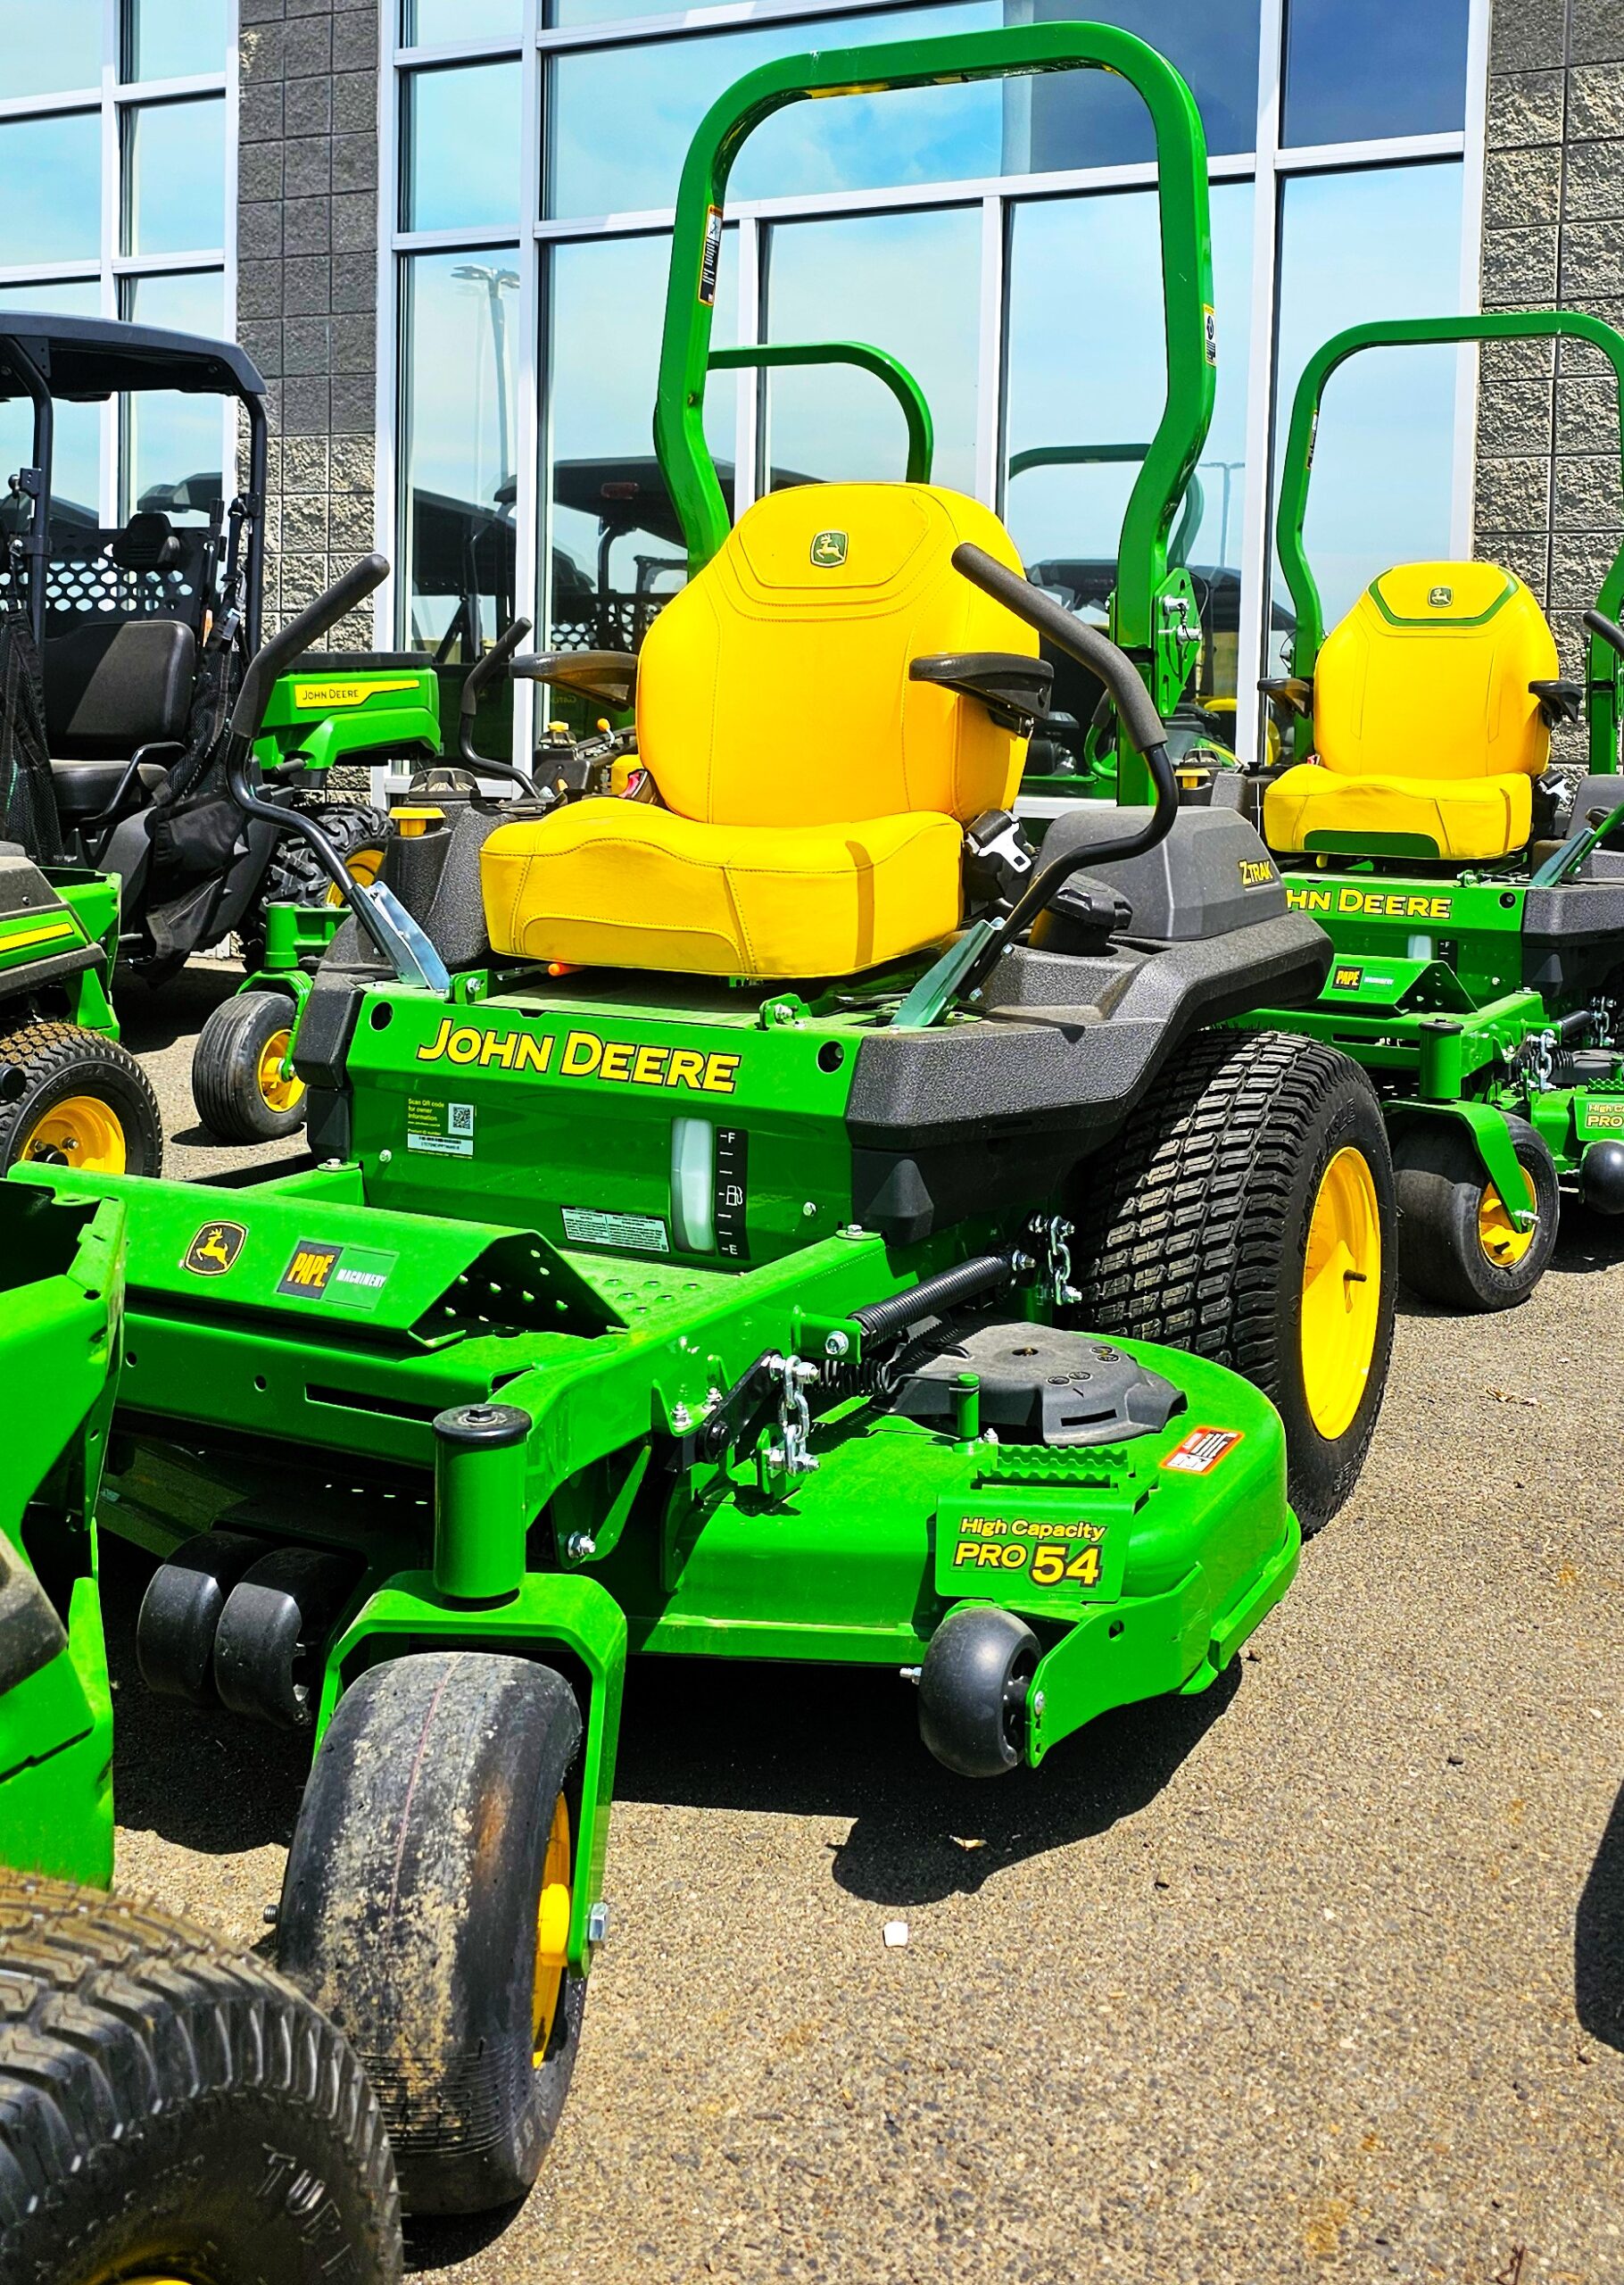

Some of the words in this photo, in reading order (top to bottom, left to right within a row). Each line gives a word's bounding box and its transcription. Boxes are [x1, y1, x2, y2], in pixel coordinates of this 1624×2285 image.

[302, 690, 327, 700] JOHN
[329, 688, 359, 699] DEERE
[1239, 859, 1273, 885] ZTRAK
[1286, 888, 1332, 911] HN
[1338, 887, 1453, 918] DEERE
[416, 1018, 556, 1074] JOHN
[559, 1029, 742, 1094] DEERE
[1587, 1115, 1624, 1127] PRO
[727, 1133, 735, 1143] F
[729, 1244, 738, 1255] E
[960, 1516, 1008, 1537] High
[1010, 1518, 1108, 1542] Capacity
[953, 1541, 1028, 1569] PRO
[1029, 1541, 1104, 1589] 54
